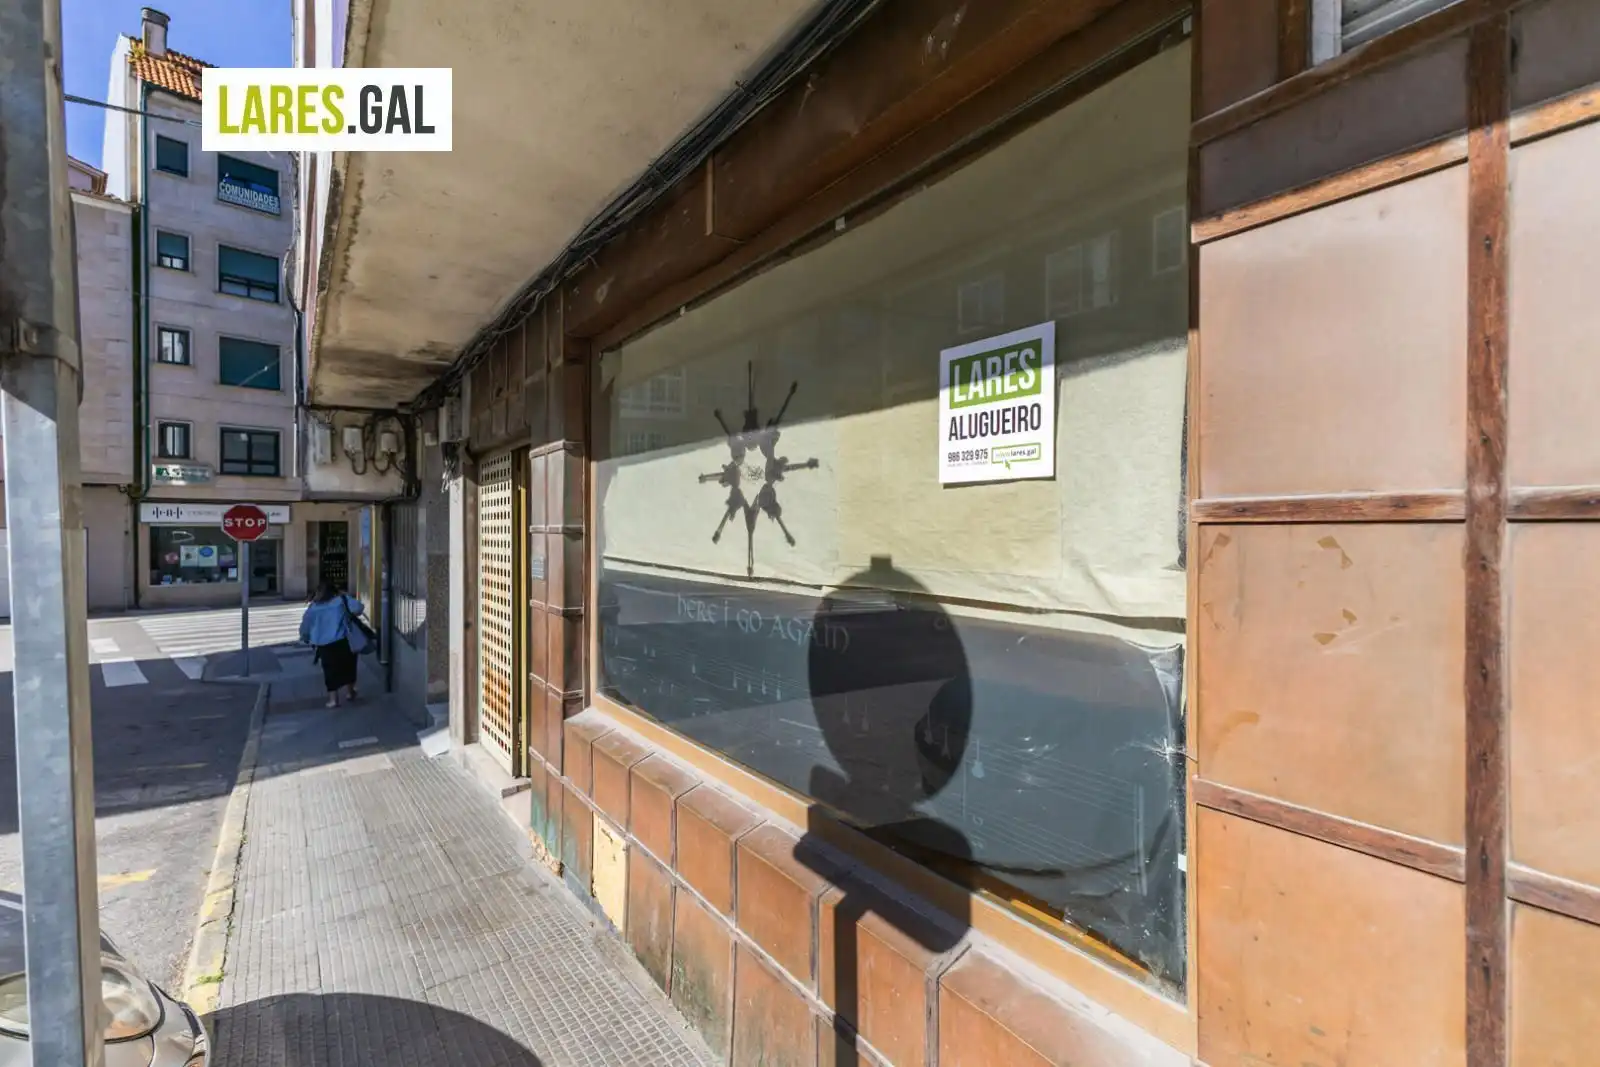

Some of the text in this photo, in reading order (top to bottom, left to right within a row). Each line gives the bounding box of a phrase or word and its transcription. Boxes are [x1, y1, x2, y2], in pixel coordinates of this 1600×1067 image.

[219, 181, 279, 207] COMUNIDADES
[953, 347, 1036, 403] LARES
[948, 402, 1042, 441] ALUGUEIRO
[948, 448, 988, 463] 986 329 975
[224, 517, 266, 528] STOP
[736, 608, 763, 633] GO
